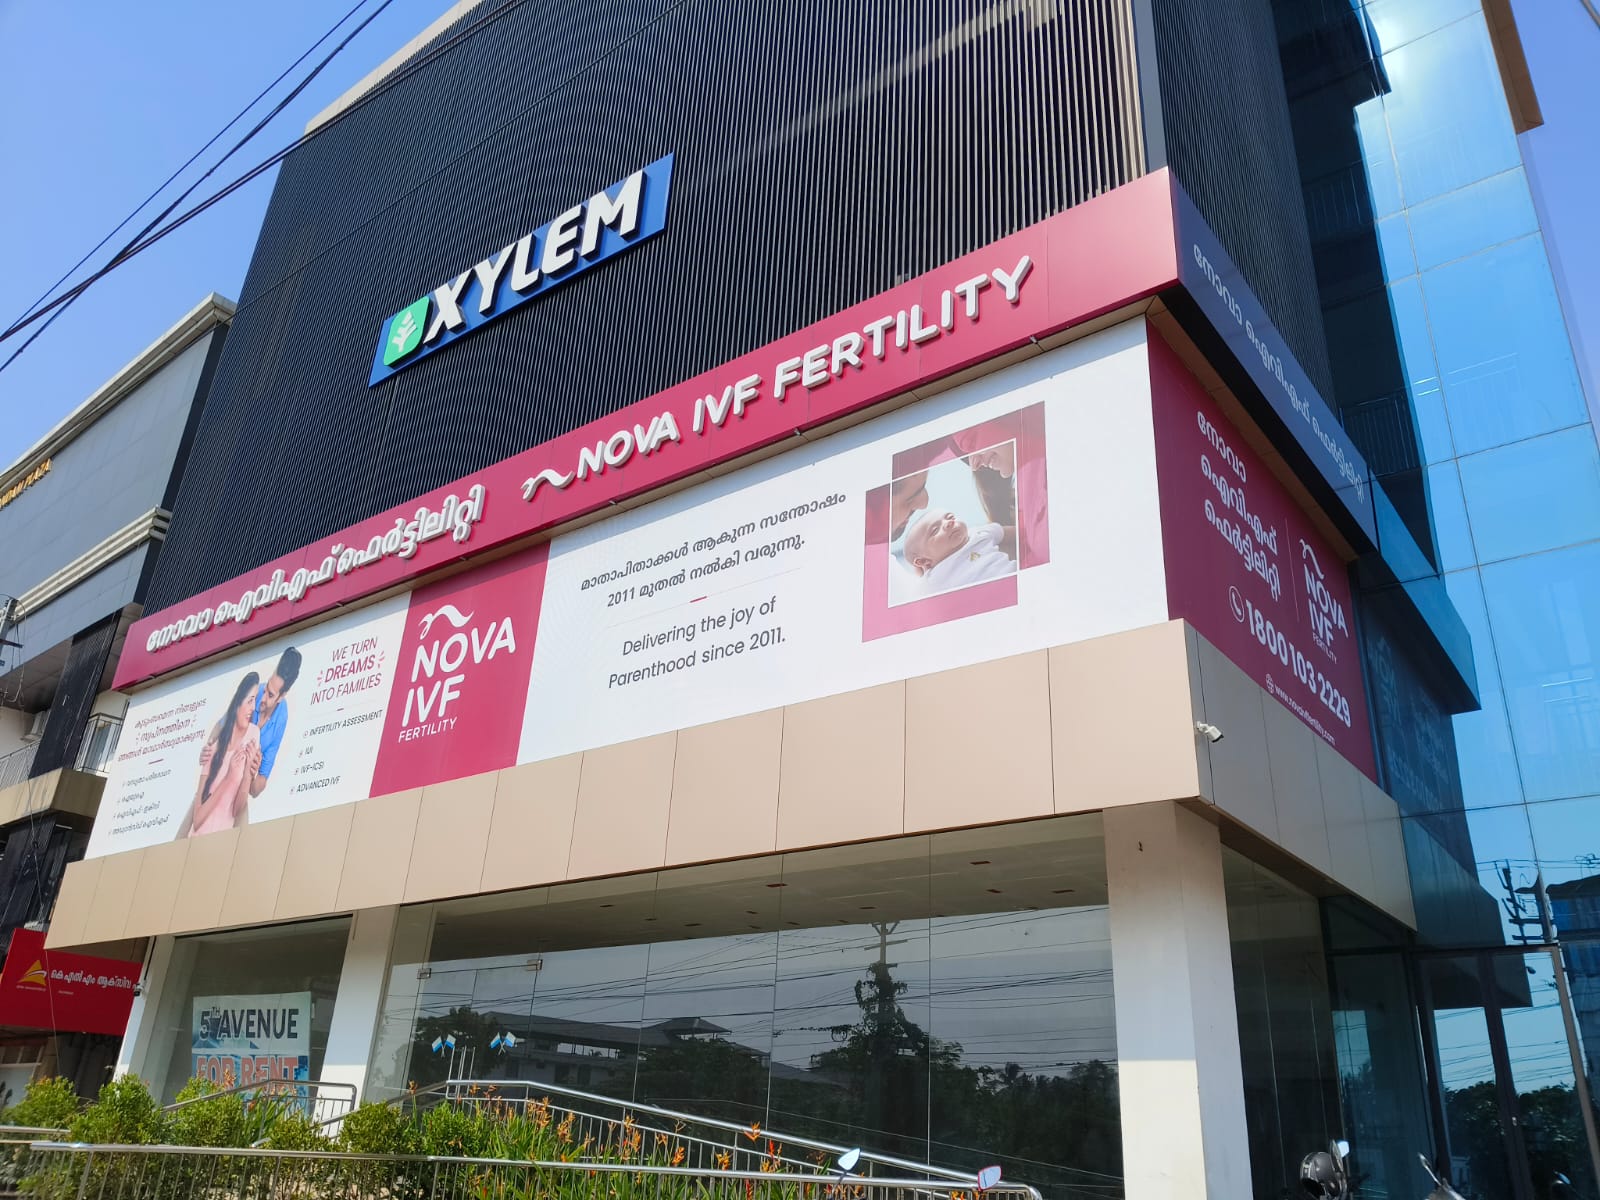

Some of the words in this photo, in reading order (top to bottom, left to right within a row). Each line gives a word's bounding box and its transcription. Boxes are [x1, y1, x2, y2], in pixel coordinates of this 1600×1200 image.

[422, 169, 644, 345] XYLEM
[1193, 243, 1243, 326] നോവാ
[577, 411, 681, 481] NOVA
[693, 373, 762, 434] IVF
[773, 255, 1034, 401] FERTILITY
[1197, 410, 1247, 483] നോവാ
[1201, 454, 1278, 556] ഐവിഎഫ്
[146, 608, 215, 654] നോവാ
[213, 543, 345, 625] ഐവിഎഫ്
[336, 483, 486, 575] ഫെർട്ടിലിറ്റി
[580, 542, 689, 591] മാതാപിതാക്കൾ
[692, 521, 756, 552] ആകുന്ന
[759, 493, 847, 530] സന്തോഷം
[1204, 498, 1281, 602] ഫെർട്ടിലിറ്റി
[606, 587, 636, 608] 2011
[638, 569, 686, 598] മുതൽ
[689, 550, 741, 581] നൽകി
[1303, 563, 1349, 639] NOVA
[332, 645, 349, 663] WE
[350, 636, 378, 656] TURN
[411, 616, 517, 683] NOVA
[622, 623, 696, 656] Delivering
[700, 615, 727, 633] the
[728, 605, 756, 630] joy
[758, 595, 777, 616] of
[1307, 597, 1335, 648] IVF
[1311, 631, 1338, 665] FERTILITY
[324, 654, 376, 683] DREAMS
[608, 650, 697, 689] Parenthood
[701, 640, 745, 663] since
[749, 626, 786, 651] 2011.
[1245, 599, 1289, 667] 1800
[1289, 642, 1318, 695] 103
[1317, 672, 1352, 728] 2229
[310, 687, 335, 706] INTO
[336, 672, 383, 698] FAMILIES
[401, 673, 466, 728] IVF
[308, 721, 342, 737] INFERTILITY
[341, 709, 383, 728] ASSESSMENT
[398, 717, 458, 743] FERTILITY
[296, 777, 330, 793] ADVANCED
[329, 776, 341, 785] IVF
[216, 1008, 300, 1040] AVENUE
[197, 1055, 236, 1089] FOR
[241, 1055, 299, 1094] RENT
